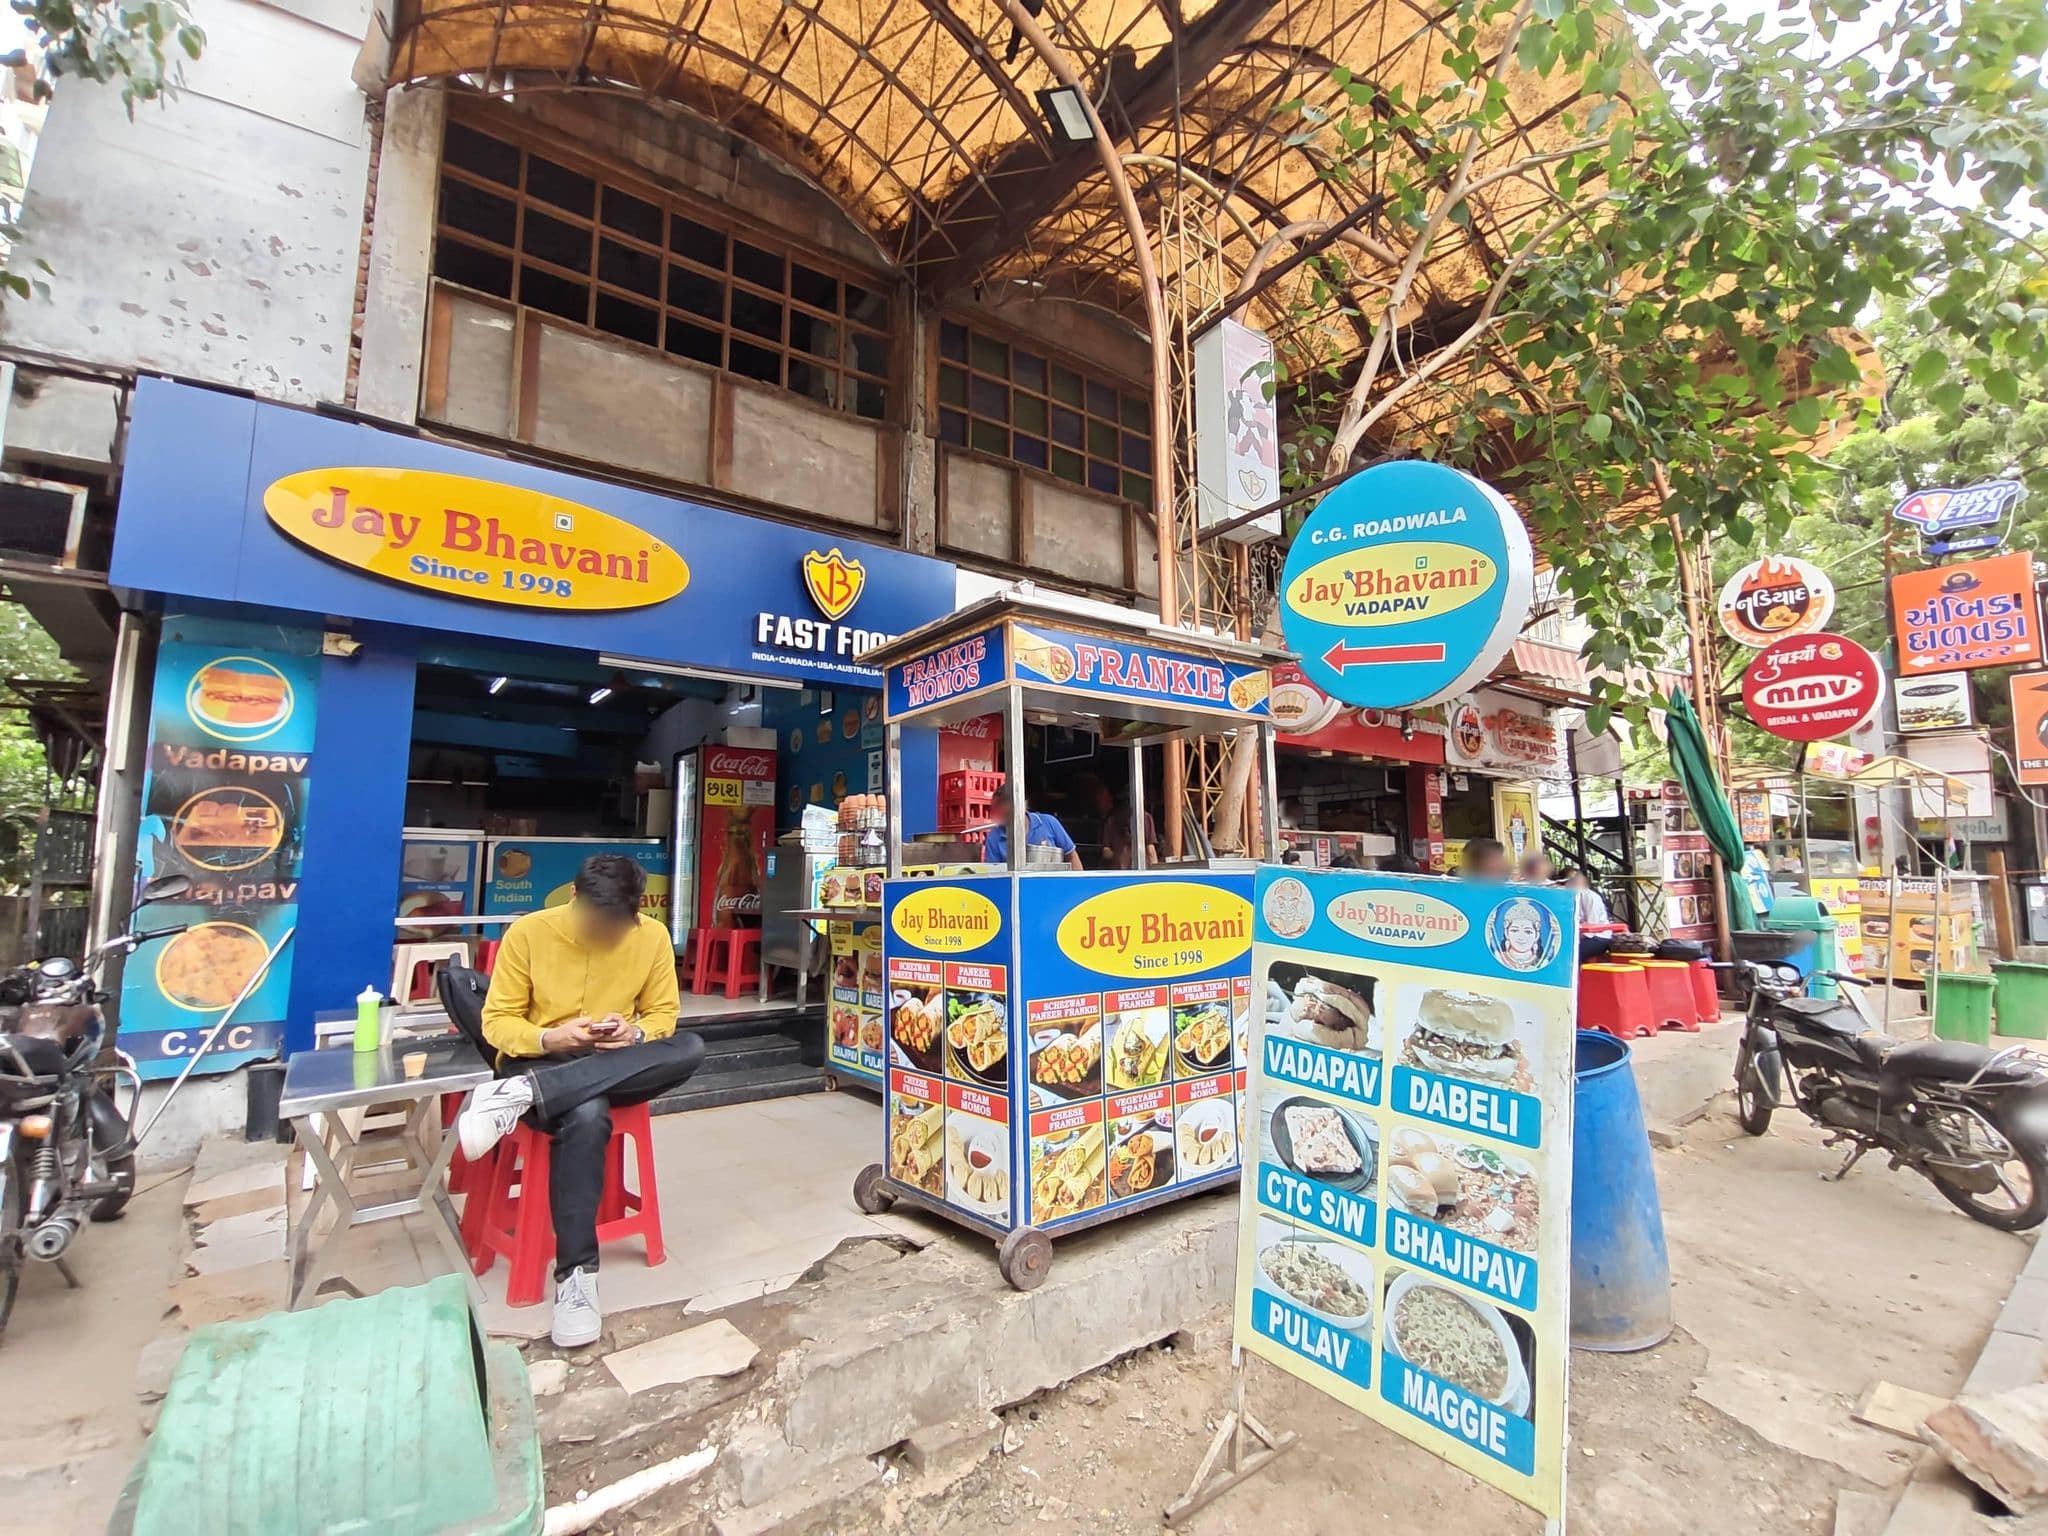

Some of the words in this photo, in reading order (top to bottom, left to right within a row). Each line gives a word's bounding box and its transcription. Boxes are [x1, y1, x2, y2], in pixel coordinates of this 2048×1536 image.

[312, 486, 420, 549] Jay
[442, 509, 651, 584] Bhavani
[1311, 526, 1348, 545] C.G.
[1352, 507, 1467, 539] ROADWALA
[1948, 538, 1985, 550] PIZZA
[409, 555, 490, 585] Since
[502, 570, 573, 598] 1998
[1299, 577, 1344, 606] Jay
[1353, 558, 1480, 597] Bhavani
[1344, 595, 1430, 617] VADAPAV
[758, 612, 831, 652] FAST
[837, 626, 900, 658] FOO
[903, 636, 986, 687] FRANKIE
[1074, 643, 1226, 702] FRANKIE
[909, 663, 980, 707] MOMOS
[1766, 679, 1847, 705] mmv
[1767, 714, 1799, 726] MISAL
[1802, 713, 1810, 723] &
[1812, 708, 1858, 721] VADAPAV
[164, 744, 307, 776] Vadapav
[496, 880, 533, 890] South
[494, 893, 533, 903] Indian
[901, 908, 924, 932] Jay
[928, 905, 989, 931] Bhavani
[1336, 901, 1374, 925] Jay
[1374, 904, 1459, 932] Bhavani
[924, 935, 942, 946] Since
[944, 935, 962, 947] 1998
[1080, 916, 1131, 954] Jay
[1141, 911, 1245, 944] Bhavani
[1368, 926, 1426, 941] VADAPAV
[1134, 954, 1169, 970] Since
[1173, 950, 1203, 967] 1998
[958, 966, 991, 978] PANEER
[957, 976, 993, 989] FRANKIE
[1043, 998, 1086, 1011] SCHEZWAN
[1118, 990, 1155, 1001] MEXICAN
[1118, 998, 1155, 1010] FRANKIE
[1184, 991, 1218, 1002] FRANKIE
[1030, 1009, 1063, 1022] PANEER
[1064, 1005, 1098, 1018] FRANKIE
[1266, 1040, 1378, 1099] VADAPAV
[903, 1074, 928, 1090] CHEESE
[1190, 1078, 1217, 1092] STEAM
[902, 1085, 930, 1099] FRANKIE
[961, 1089, 990, 1106] STEAM
[1114, 1090, 1164, 1109] VEGETABLE
[1189, 1085, 1219, 1101] MOMOS
[960, 1100, 992, 1117] MOMOS
[1050, 1107, 1085, 1123] CHEESE
[1121, 1098, 1159, 1116] FRANKIE
[1408, 1075, 1519, 1138] DABELI
[1049, 1115, 1086, 1132] FRANKIE
[1266, 1170, 1313, 1216] CTC
[1319, 1189, 1366, 1237] S/W
[1393, 1216, 1527, 1300] BHAJIPAV
[1268, 1301, 1351, 1371] PULAV
[1403, 1368, 1508, 1457] MAGGIE
